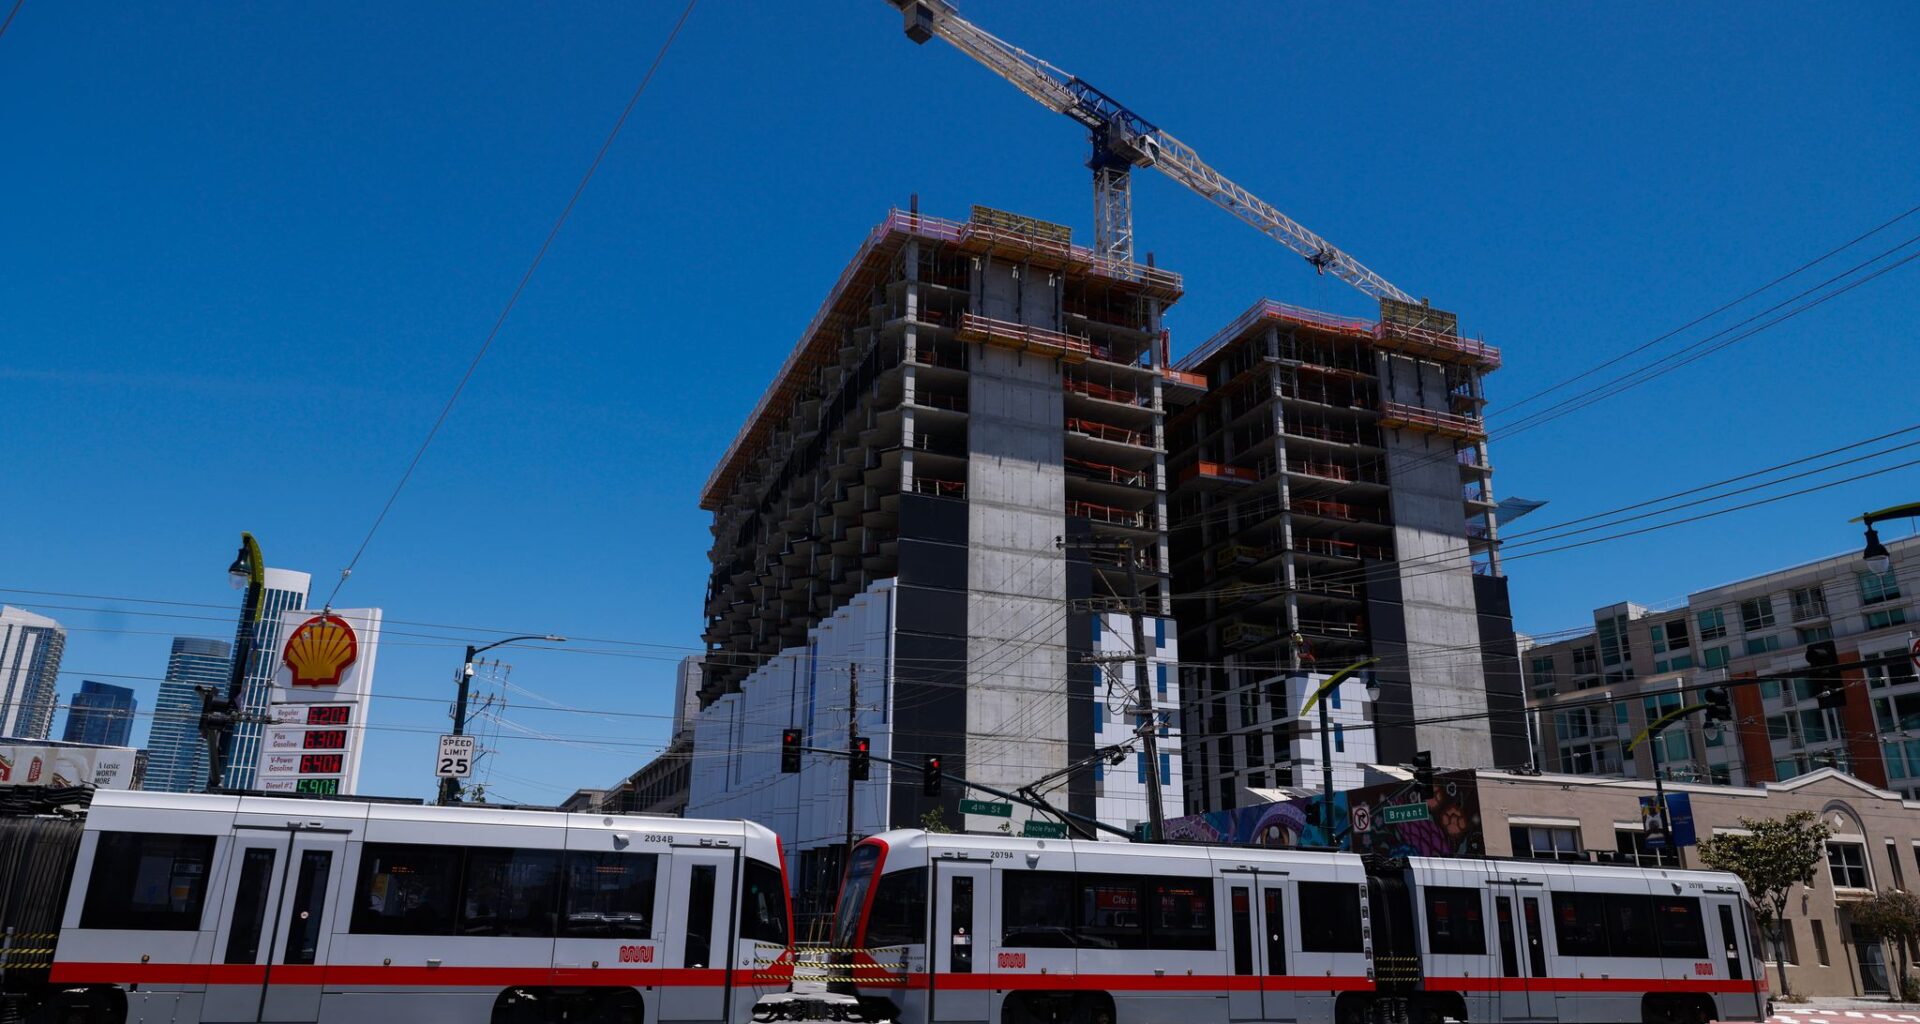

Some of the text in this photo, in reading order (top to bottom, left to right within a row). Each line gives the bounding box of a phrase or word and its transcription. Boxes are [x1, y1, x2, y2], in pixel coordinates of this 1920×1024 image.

[278, 709, 299, 717] Regular
[440, 758, 468, 774] 25
[990, 805, 1000, 813] St
[1389, 808, 1422, 820] Bryant
[645, 835, 673, 843] 2034B
[991, 851, 1014, 859] 2079A
